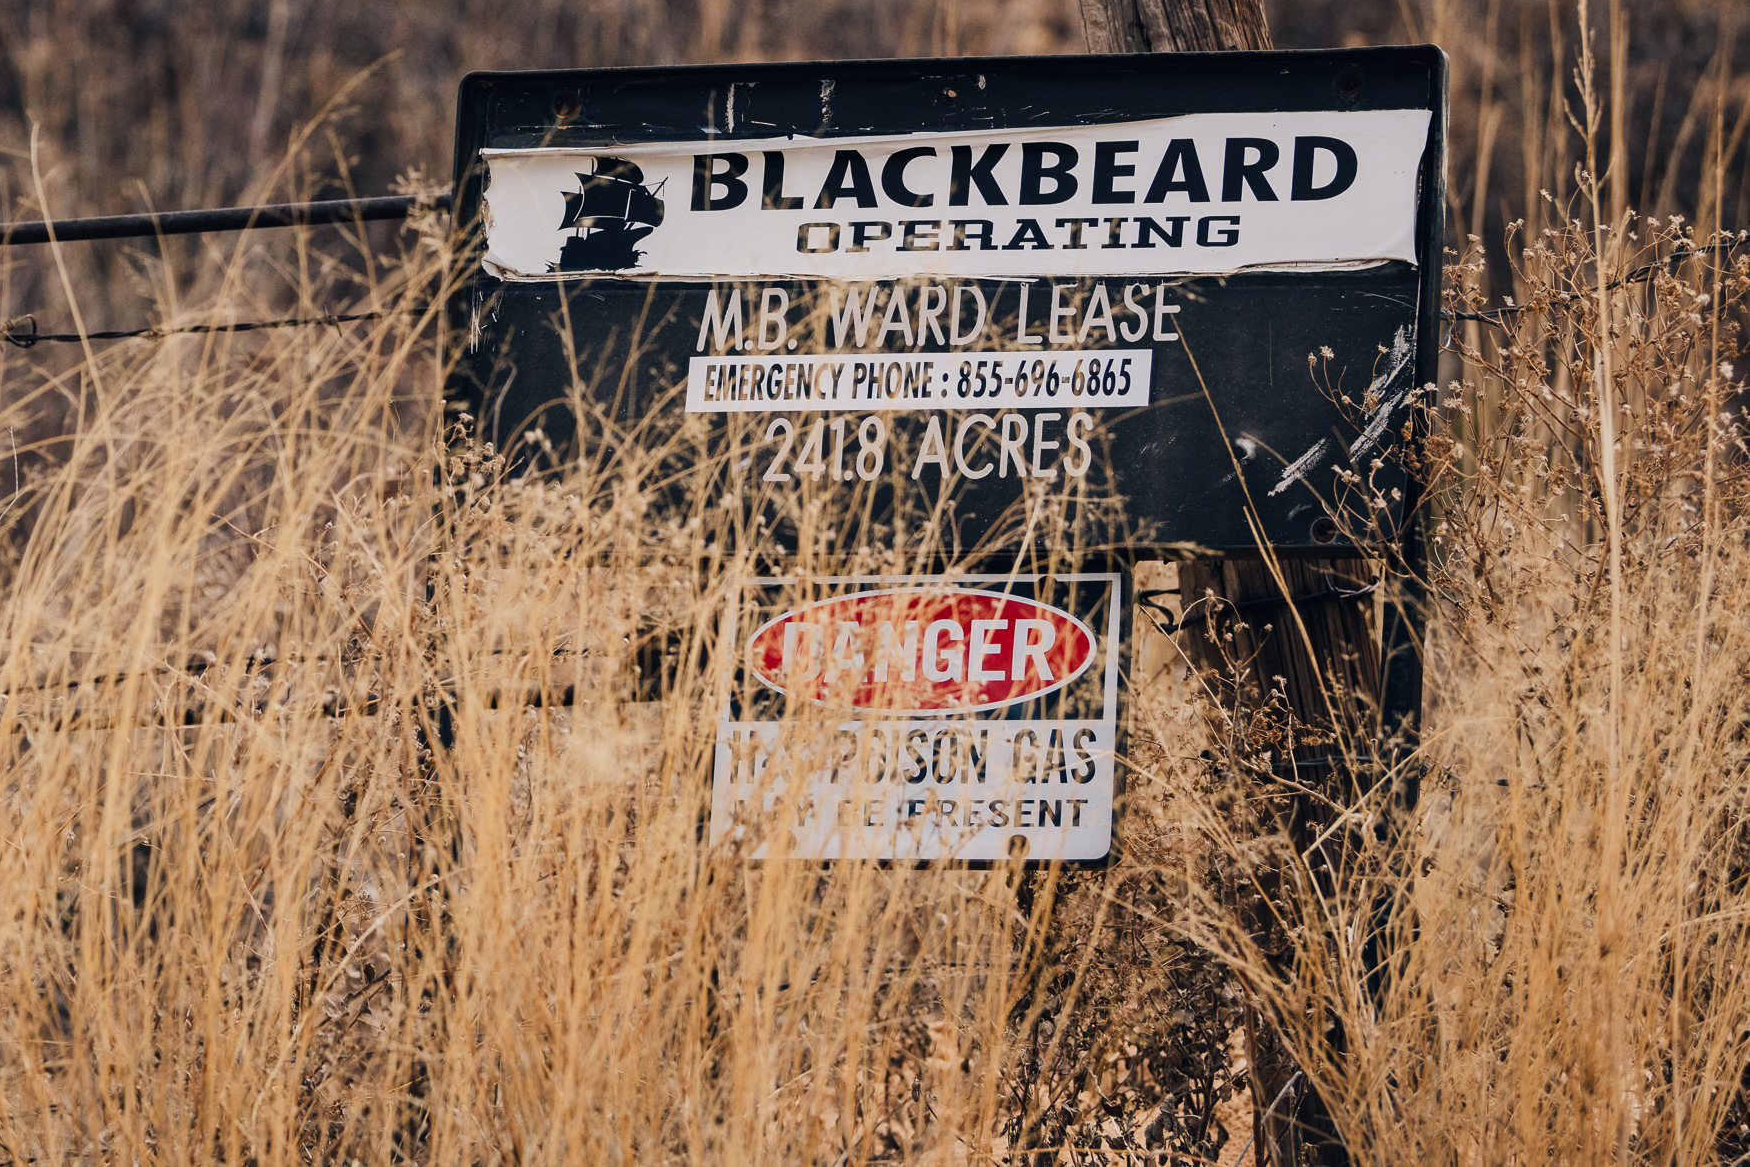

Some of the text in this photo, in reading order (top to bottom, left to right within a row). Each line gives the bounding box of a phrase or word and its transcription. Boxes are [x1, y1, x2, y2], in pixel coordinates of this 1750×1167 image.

[689, 135, 1359, 212] BLACKBEARD
[795, 215, 1241, 254] OPERATING
[696, 281, 1181, 352] M.B. WARD LEASE
[703, 361, 846, 402] EMERGENCY
[956, 357, 1132, 399] 855-696-6865
[762, 411, 1094, 482] 241.8 ACRES
[781, 617, 1057, 684] DANGER
[830, 728, 989, 785] POISON
[1012, 727, 1097, 785] GAS
[907, 799, 1089, 828] PRESENT
